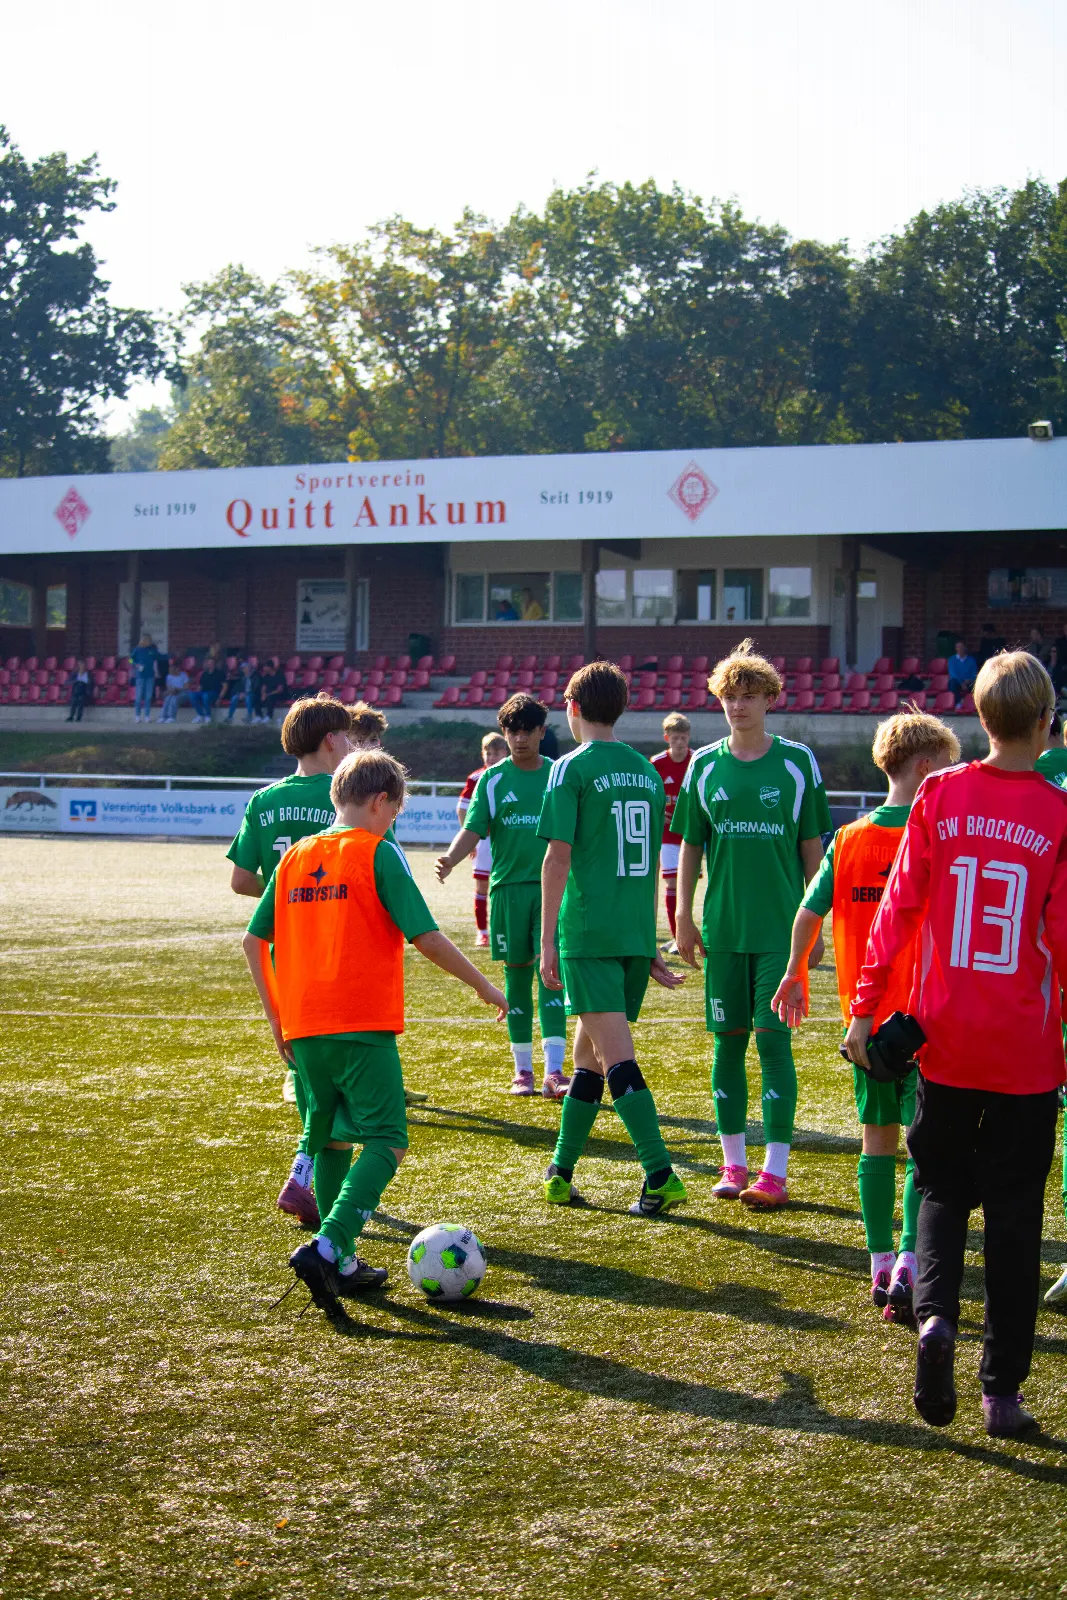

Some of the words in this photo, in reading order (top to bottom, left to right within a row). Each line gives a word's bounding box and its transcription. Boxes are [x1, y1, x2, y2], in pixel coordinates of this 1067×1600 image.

[296, 469, 426, 494] Sportverein
[539, 490, 569, 505] Seit
[578, 490, 613, 504] 1919
[133, 502, 160, 517] Seit
[166, 502, 197, 516] 1919
[225, 497, 335, 538] Quitt
[353, 493, 507, 528] Ankum
[593, 774, 611, 793] GW
[611, 772, 658, 795] BROCKDORF
[102, 801, 157, 816] Vereinigte
[160, 802, 216, 816] Volksbank
[220, 804, 236, 816] eG
[259, 809, 275, 827] GW
[279, 806, 337, 827] BROCKDOR
[501, 813, 541, 826] WÖHRM
[713, 818, 785, 836] WÖHRMANN
[937, 816, 959, 841] GW
[966, 815, 1053, 857] BROCKDORF
[610, 800, 651, 877] 19
[950, 855, 1029, 975] 13
[496, 933, 508, 953] 5
[709, 997, 726, 1022] 16
